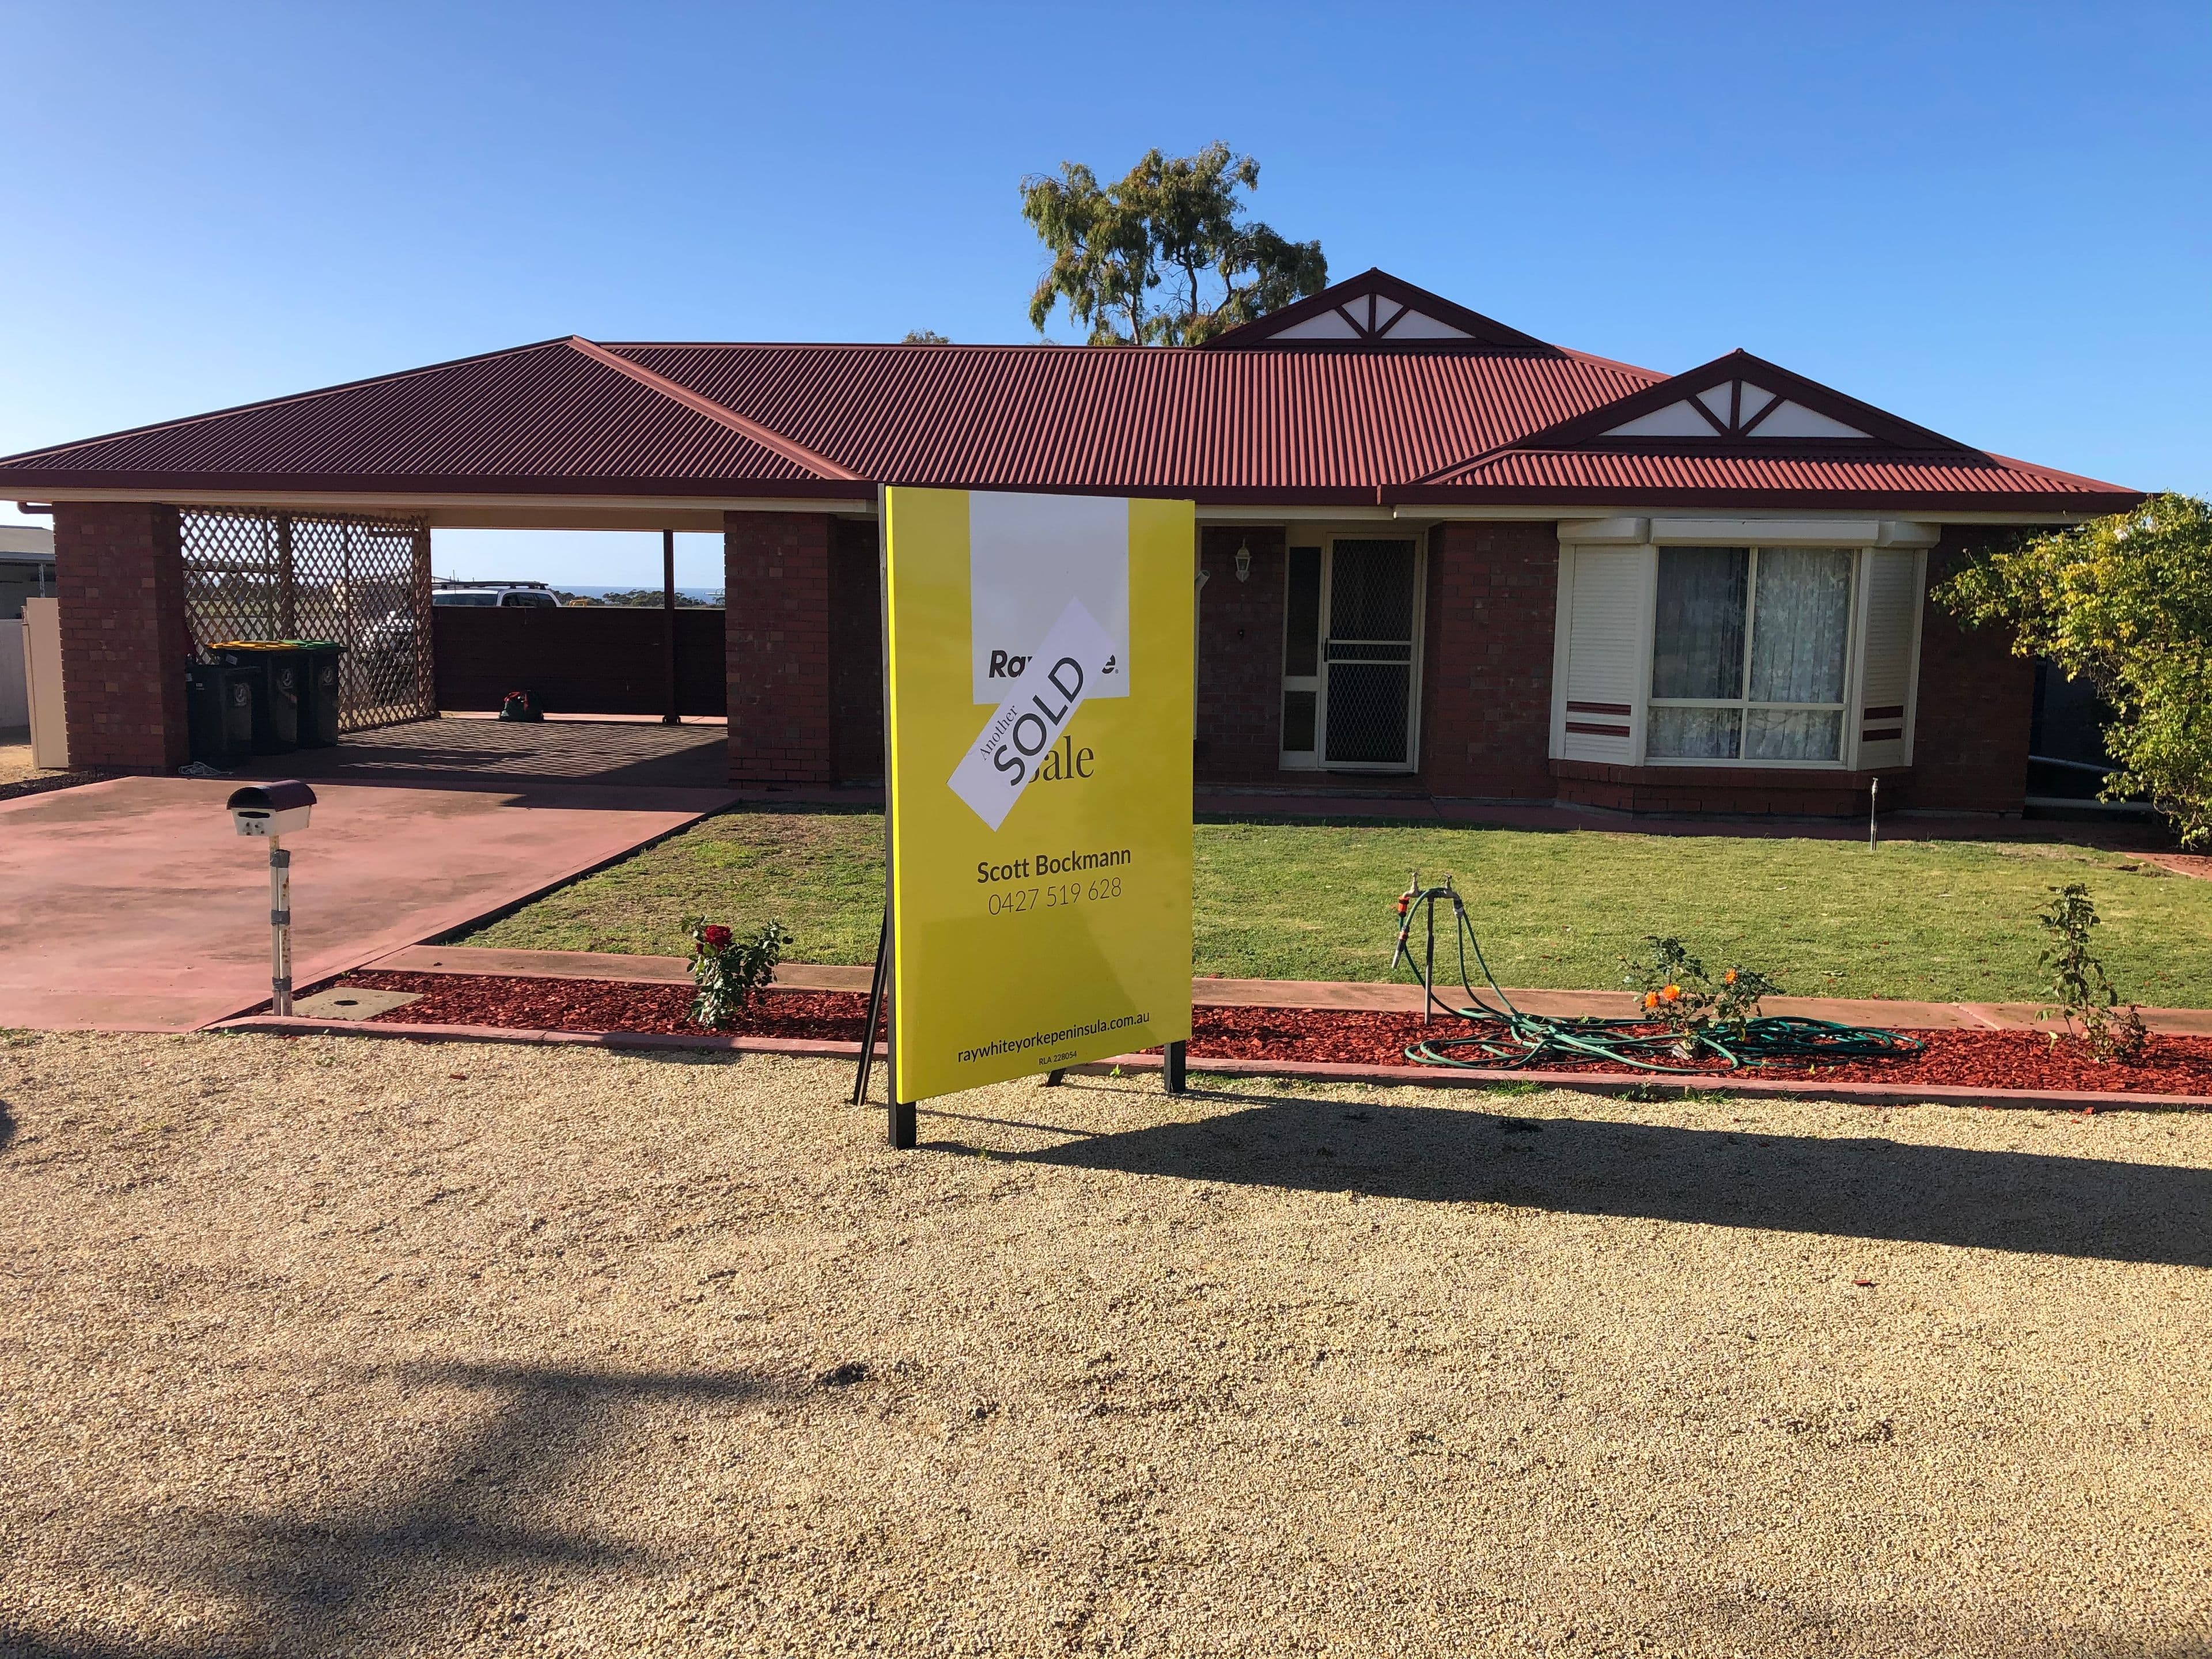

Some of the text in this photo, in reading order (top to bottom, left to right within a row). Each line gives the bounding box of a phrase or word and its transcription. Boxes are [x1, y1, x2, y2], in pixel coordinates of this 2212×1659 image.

[988, 650, 1033, 678] Ra
[980, 705, 1018, 760] Another
[994, 657, 1084, 786] SOLD
[977, 849, 1131, 883] Scott Bockmann
[988, 877, 1122, 915] 0427 519 628
[957, 1012, 1150, 1063] raywhiteyorkepeninsula.com.au
[1039, 1050, 1077, 1066] RLA 228054
